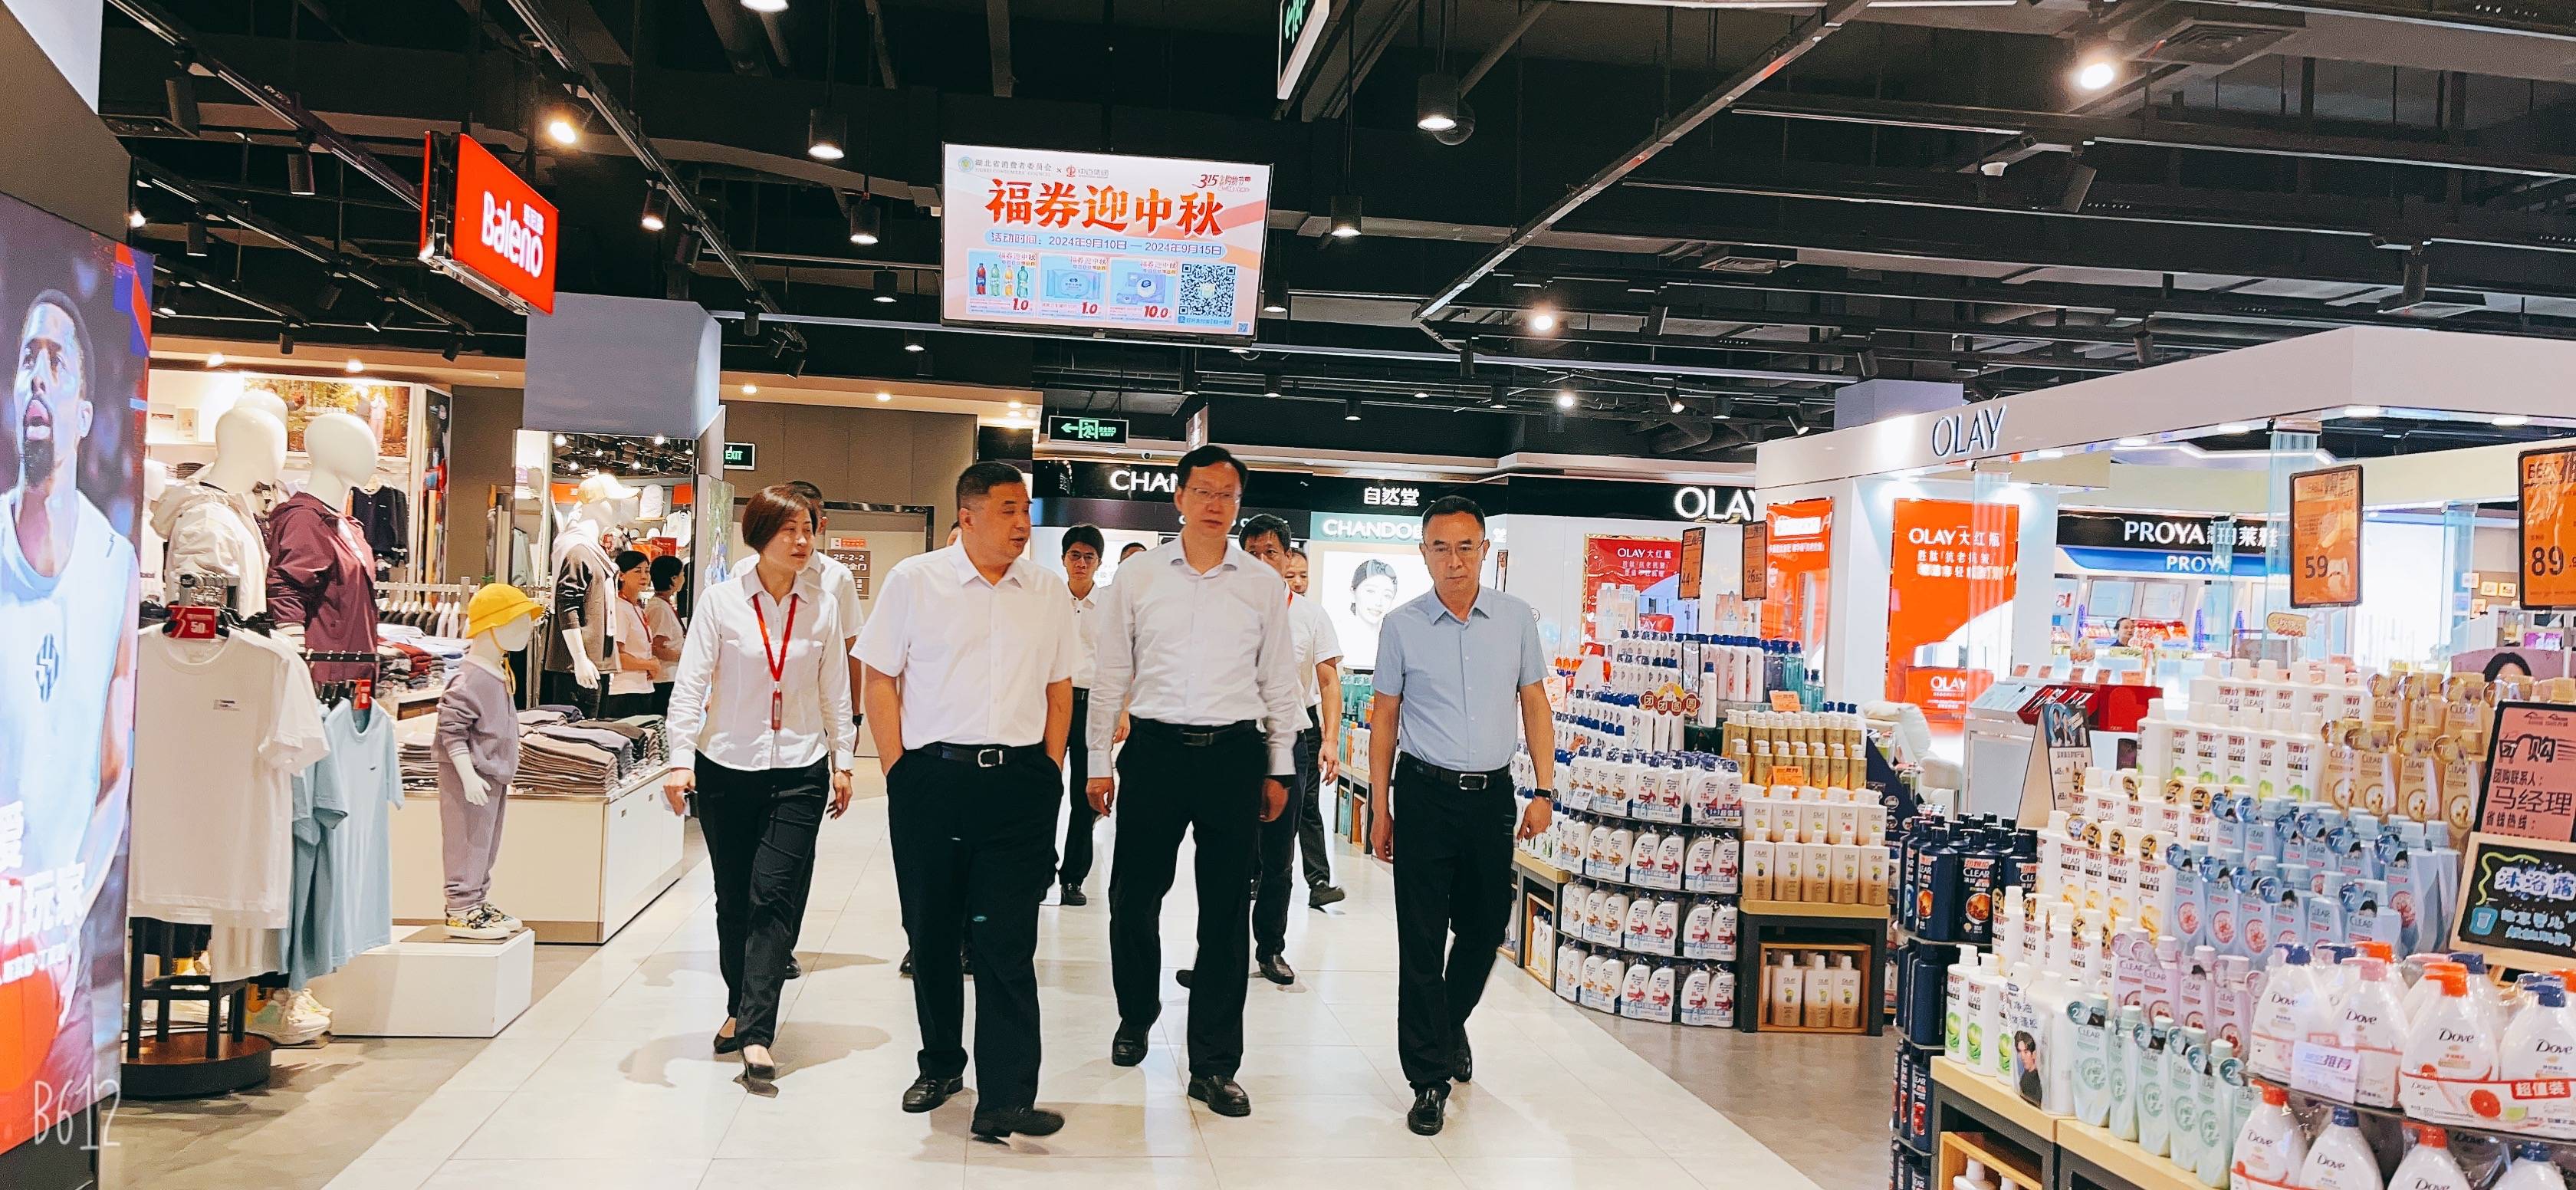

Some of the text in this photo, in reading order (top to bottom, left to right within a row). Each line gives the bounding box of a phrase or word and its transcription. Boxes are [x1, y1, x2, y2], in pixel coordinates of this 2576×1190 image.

[985, 178, 1224, 237] 福券迎中秋
[481, 191, 544, 278] Baleno
[1049, 236, 1127, 250] 2024年9月10日
[1145, 242, 1222, 255] 2024年9月15日
[1012, 298, 1029, 311] 1.0
[1082, 301, 1098, 314] 1.0
[1144, 305, 1168, 318] 10.0
[1933, 405, 2006, 458] OLAY
[725, 451, 743, 460] EXIT
[1363, 486, 1420, 507] 自然堂
[1908, 528, 2000, 547] OLAY 大红瓶
[2124, 521, 2206, 545] PROYA
[833, 554, 865, 562] 2F-2-2
[1617, 547, 1646, 558] OLAY
[2167, 554, 2230, 574] PROYA
[2305, 555, 2328, 579] 59
[2532, 545, 2564, 576] 89
[1930, 676, 1967, 690] OLAY
[2491, 786, 2572, 816] 马经理
[2331, 834, 2344, 847] 72
[1963, 868, 1990, 878] CLEAR
[2262, 885, 2276, 897] 72
[2342, 890, 2357, 904] 72
[2350, 915, 2374, 927] CLEAR
[2144, 969, 2167, 981] CLEAR
[2271, 992, 2299, 1007] Dove
[2346, 1008, 2377, 1026] Dove
[2077, 1027, 2100, 1038] CLEAR
[2439, 1026, 2476, 1044] Dove
[2535, 1038, 2574, 1055] Dove
[2515, 1081, 2565, 1096] 超值装
[2247, 1129, 2275, 1148] Dove
[2317, 1152, 2346, 1172] Dove
[2414, 1175, 2451, 1190] Dove
